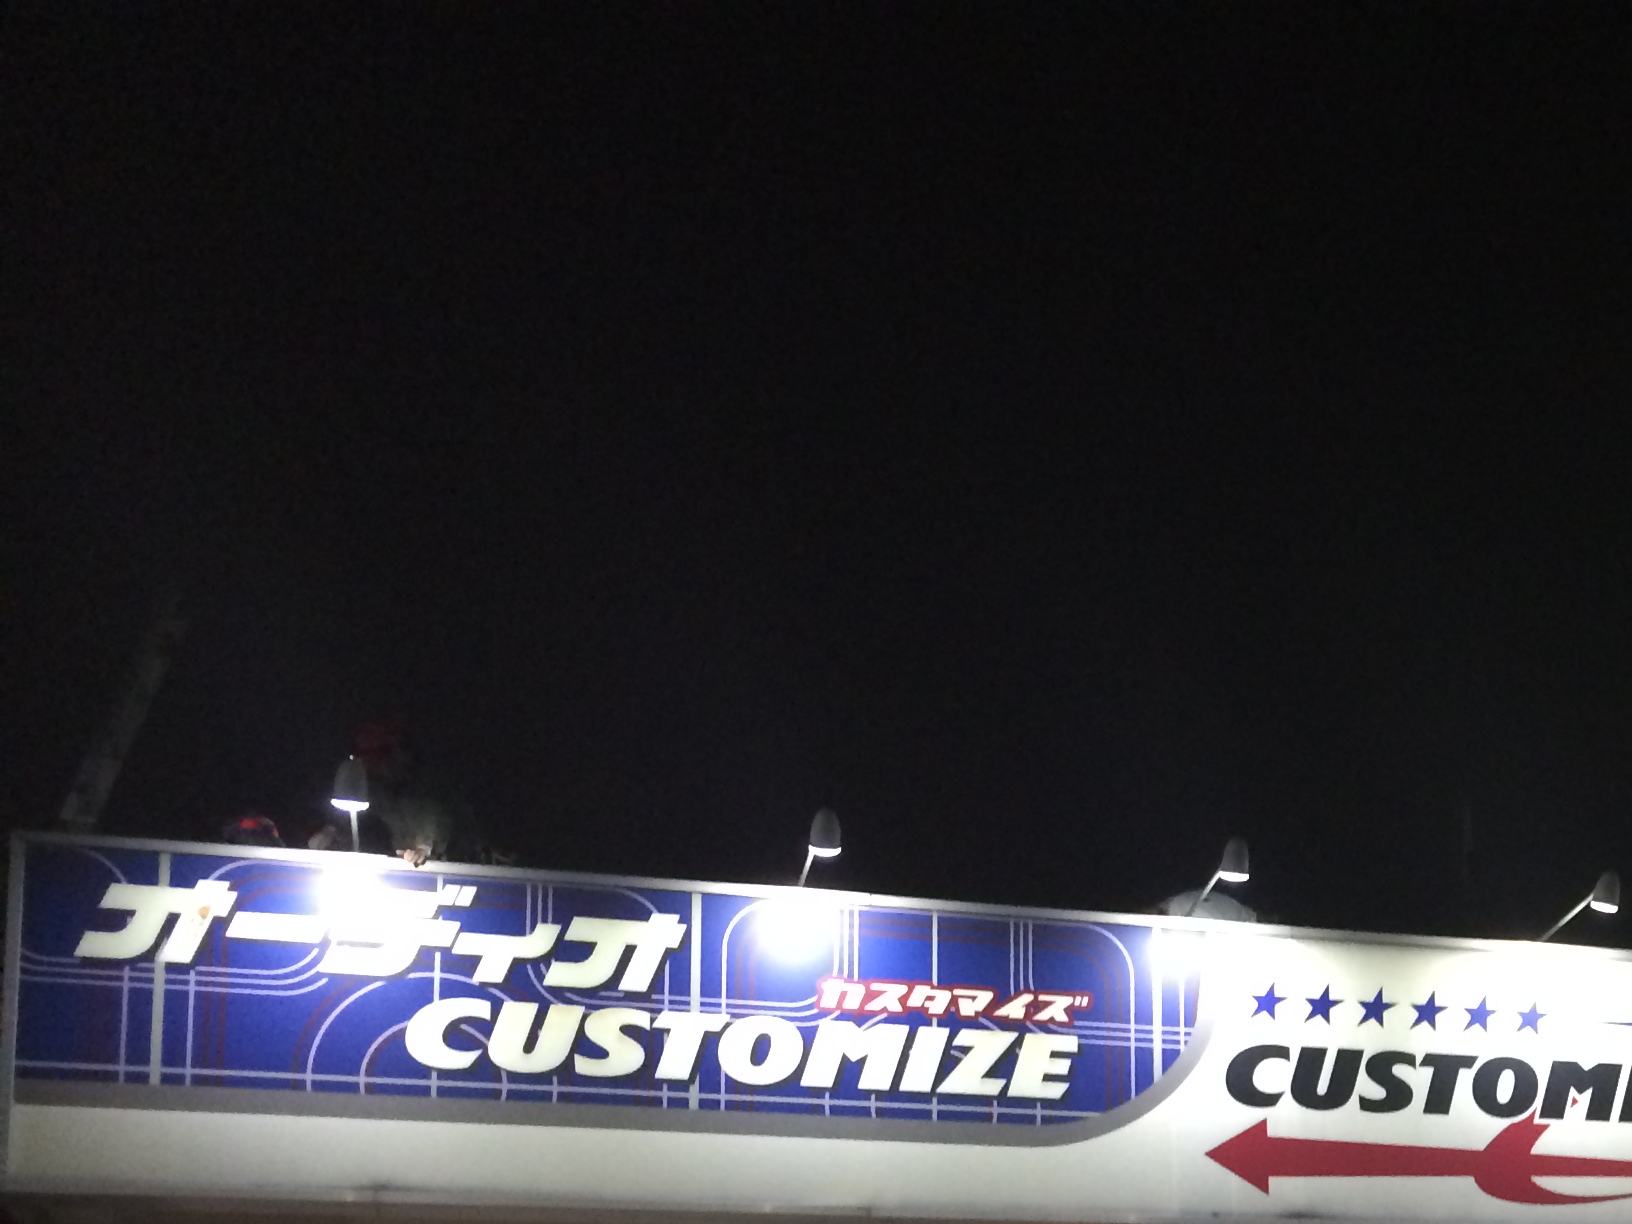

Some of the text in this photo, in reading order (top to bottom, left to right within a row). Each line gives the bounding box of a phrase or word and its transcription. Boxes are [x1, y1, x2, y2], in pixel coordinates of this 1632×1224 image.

[74, 879, 688, 992] オーディオ
[405, 998, 1079, 1100] CUSTOMIZE
[820, 978, 1089, 1023] カスタマイズ
